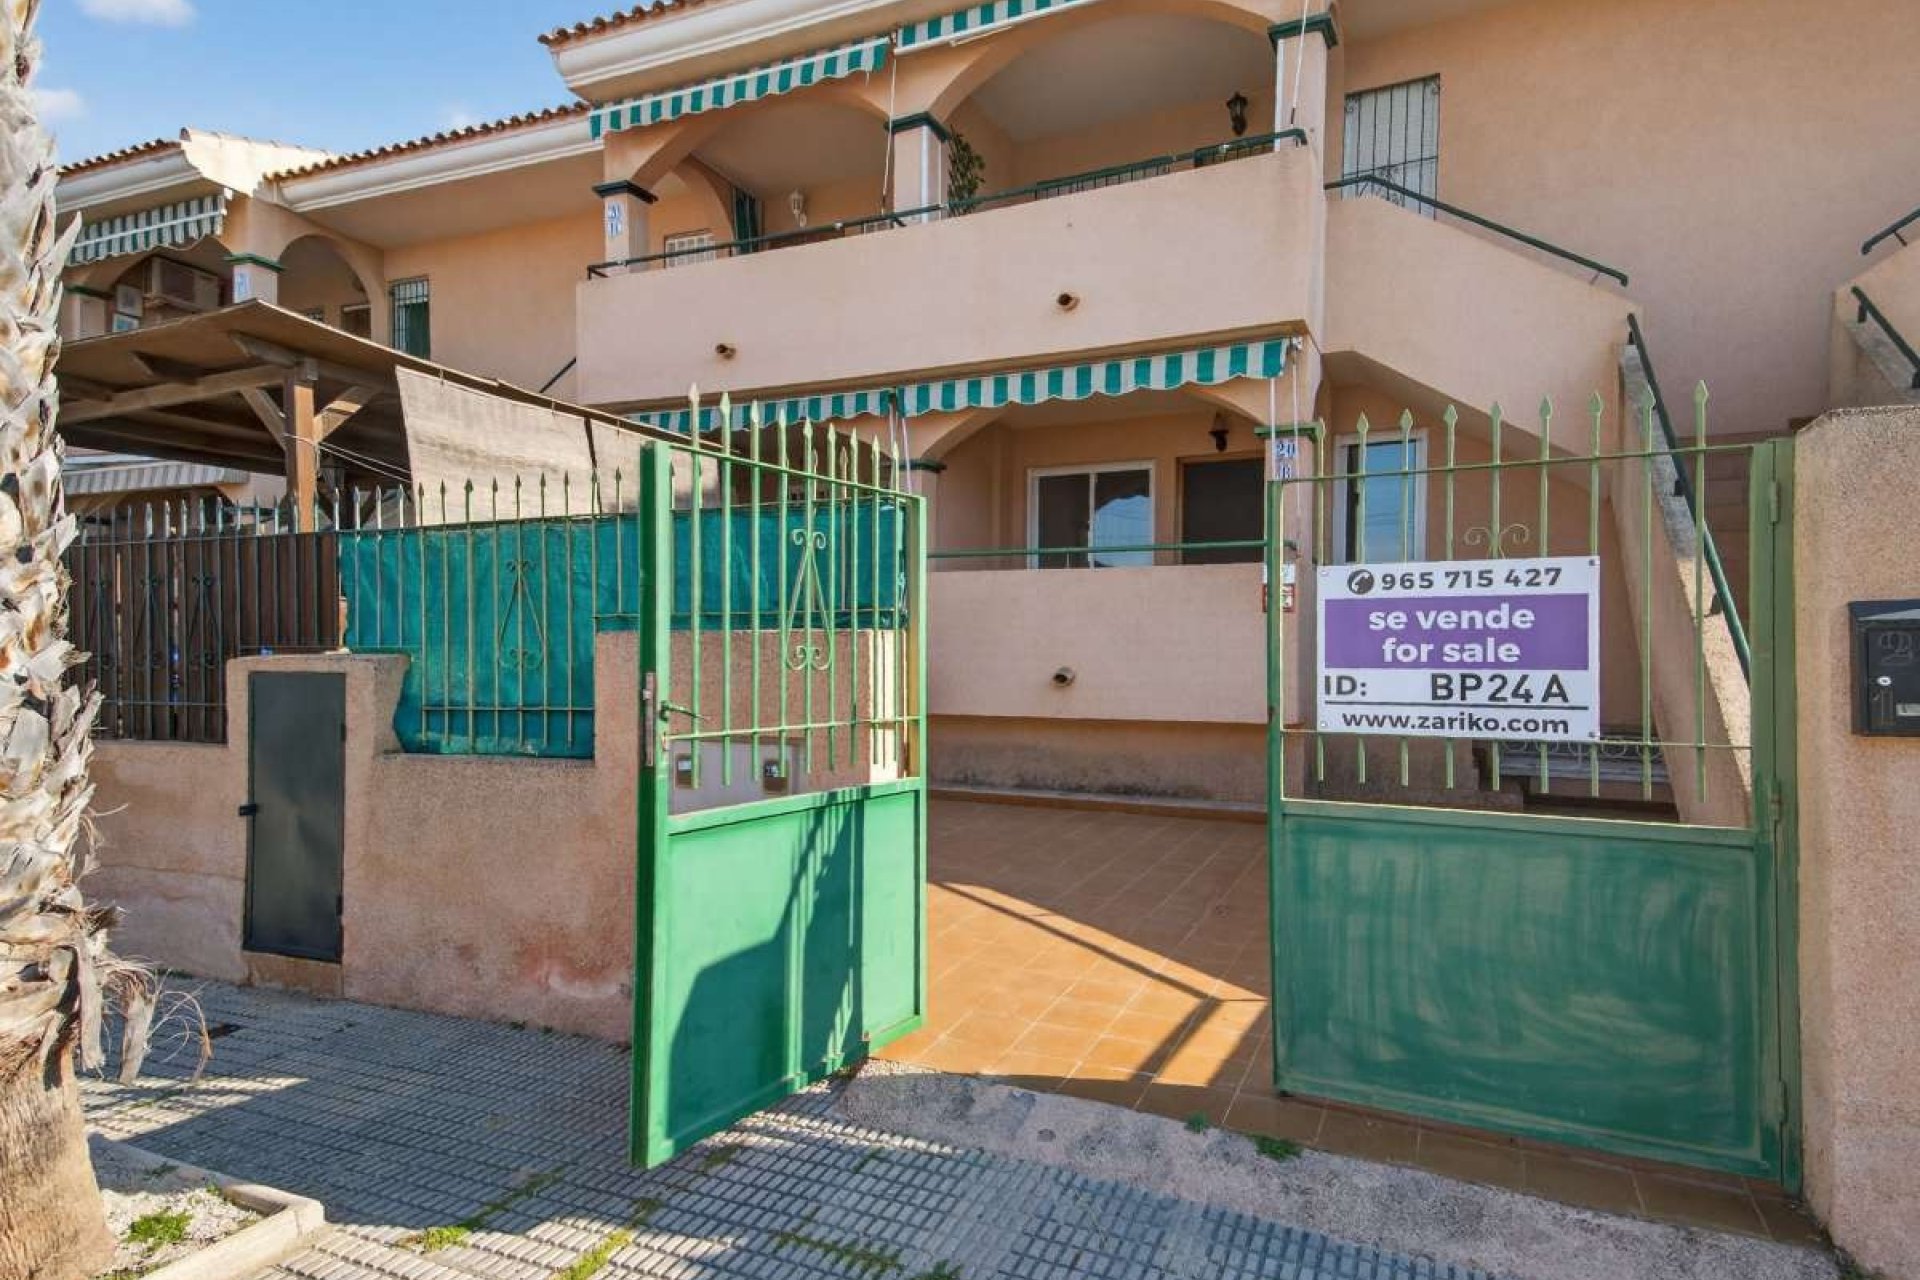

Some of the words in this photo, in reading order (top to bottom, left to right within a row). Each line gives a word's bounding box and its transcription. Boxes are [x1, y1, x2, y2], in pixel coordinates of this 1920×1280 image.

[1381, 572, 1434, 590] 965
[1445, 569, 1494, 589] 715
[1504, 567, 1562, 587] 427
[1368, 609, 1408, 631] se
[1415, 602, 1536, 630] vende
[1382, 637, 1434, 663] for
[1442, 637, 1521, 663] sale
[1324, 675, 1367, 697] ID:
[1430, 673, 1569, 704] BP24A
[1342, 711, 1569, 735] www.zariko.com
